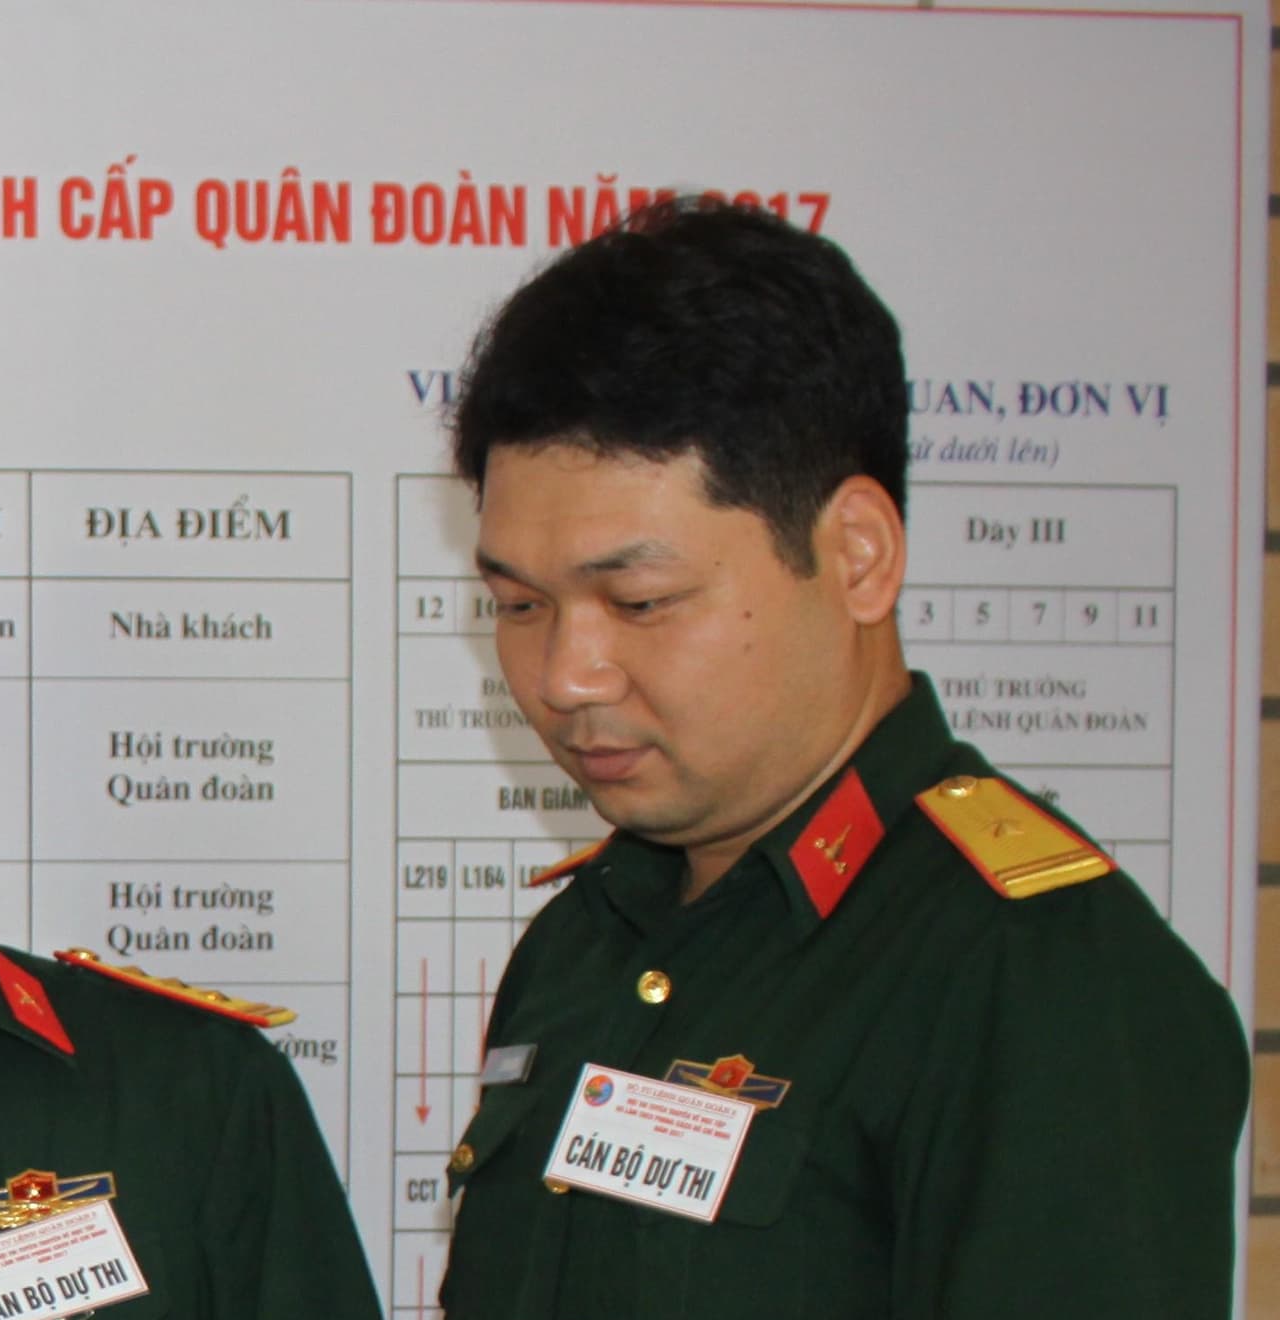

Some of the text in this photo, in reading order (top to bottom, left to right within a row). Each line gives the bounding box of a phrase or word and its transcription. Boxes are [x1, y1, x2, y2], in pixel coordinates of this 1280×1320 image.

[58, 154, 174, 241] CẤP
[195, 165, 352, 250] QUÂN
[370, 169, 527, 248] ĐOÀN
[907, 380, 1169, 427] UAN, ĐƠN VỊ
[86, 494, 291, 547] ĐỊA ĐIỂM
[1030, 518, 1067, 543] III
[109, 611, 272, 640] Nhà khách
[416, 596, 444, 619] 12
[919, 604, 934, 625] 3
[976, 604, 990, 625] 5
[1034, 605, 1046, 625] 7
[1085, 605, 1098, 626] 9
[1134, 606, 1158, 626] 11
[109, 731, 274, 765] Hội trường
[107, 773, 274, 806] Quân đoàn
[499, 786, 536, 810] BAN
[404, 865, 447, 889] L219
[463, 866, 505, 889] L164
[109, 882, 274, 915] Hội trường
[107, 924, 274, 957] Quân đoàn
[565, 1130, 717, 1201] CÁN BỘ DỰ THI
[407, 1178, 438, 1202] CCT
[22, 1277, 56, 1310] BỘ
[56, 1266, 90, 1300] DỰ
[89, 1258, 128, 1289] THI
